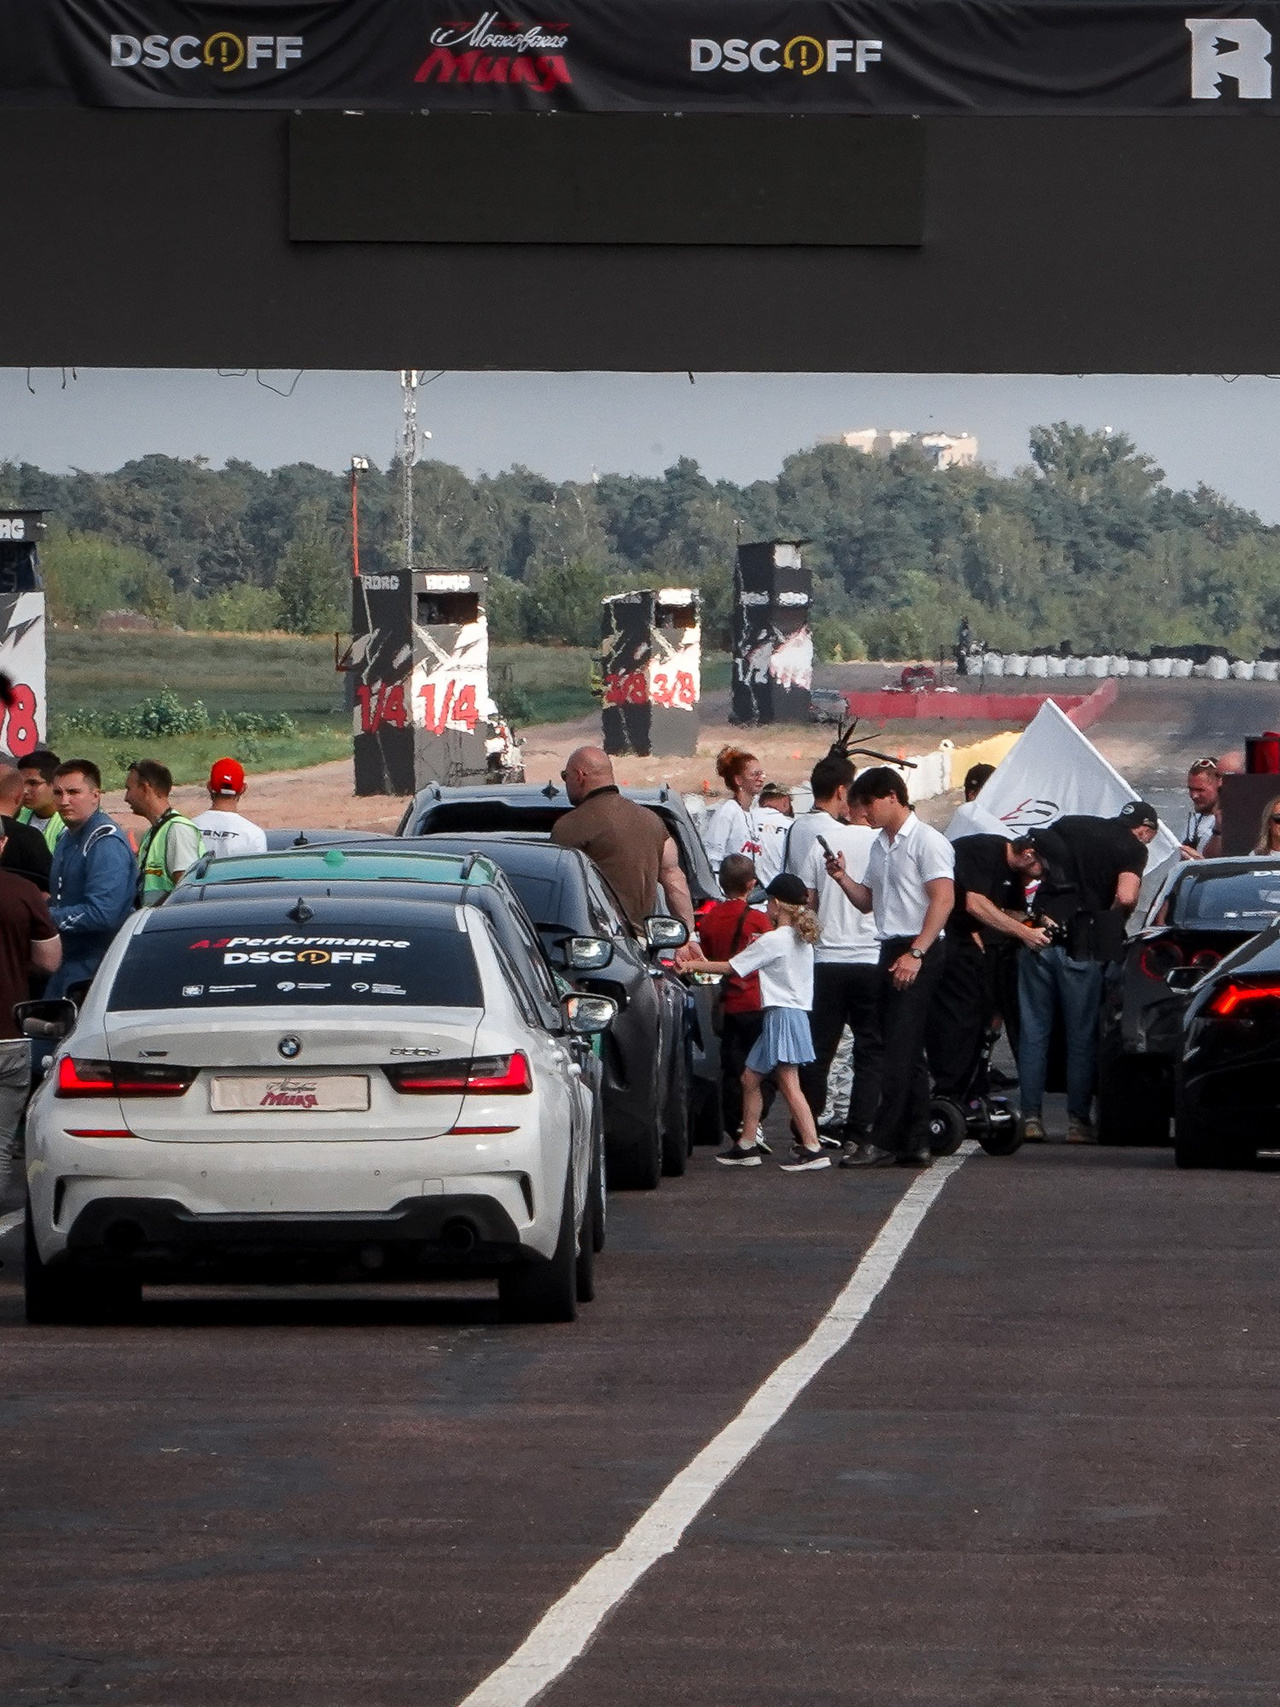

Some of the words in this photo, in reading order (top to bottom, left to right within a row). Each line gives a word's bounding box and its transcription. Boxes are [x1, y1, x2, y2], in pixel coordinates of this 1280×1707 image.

[414, 48, 573, 92] Миля
[357, 682, 407, 734] 1/4
[420, 679, 479, 734] 1/4
[652, 670, 696, 706] 3/8
[0, 683, 39, 758] 8
[200, 829, 240, 839] ENET
